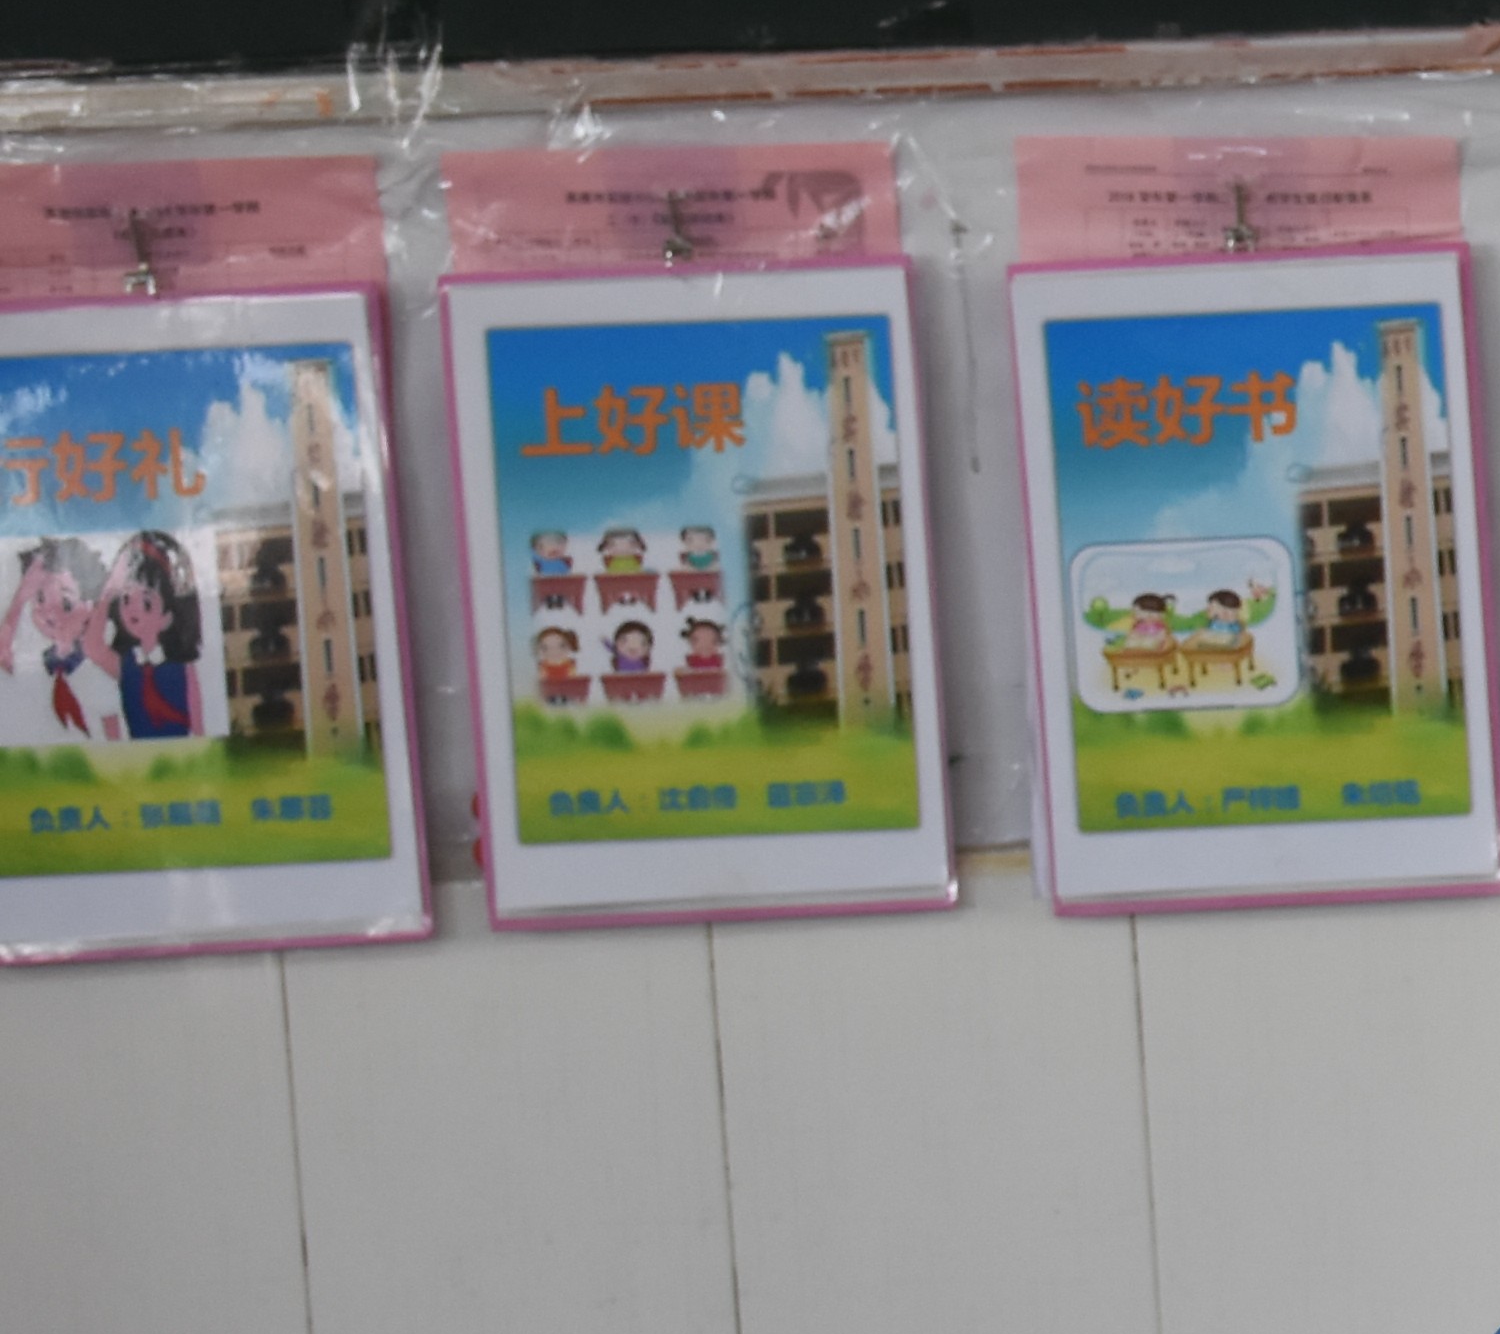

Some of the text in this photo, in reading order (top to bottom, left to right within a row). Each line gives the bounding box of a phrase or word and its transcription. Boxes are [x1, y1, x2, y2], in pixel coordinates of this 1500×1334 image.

[519, 383, 747, 459] 上好课
[1077, 370, 1299, 449] 读好书
